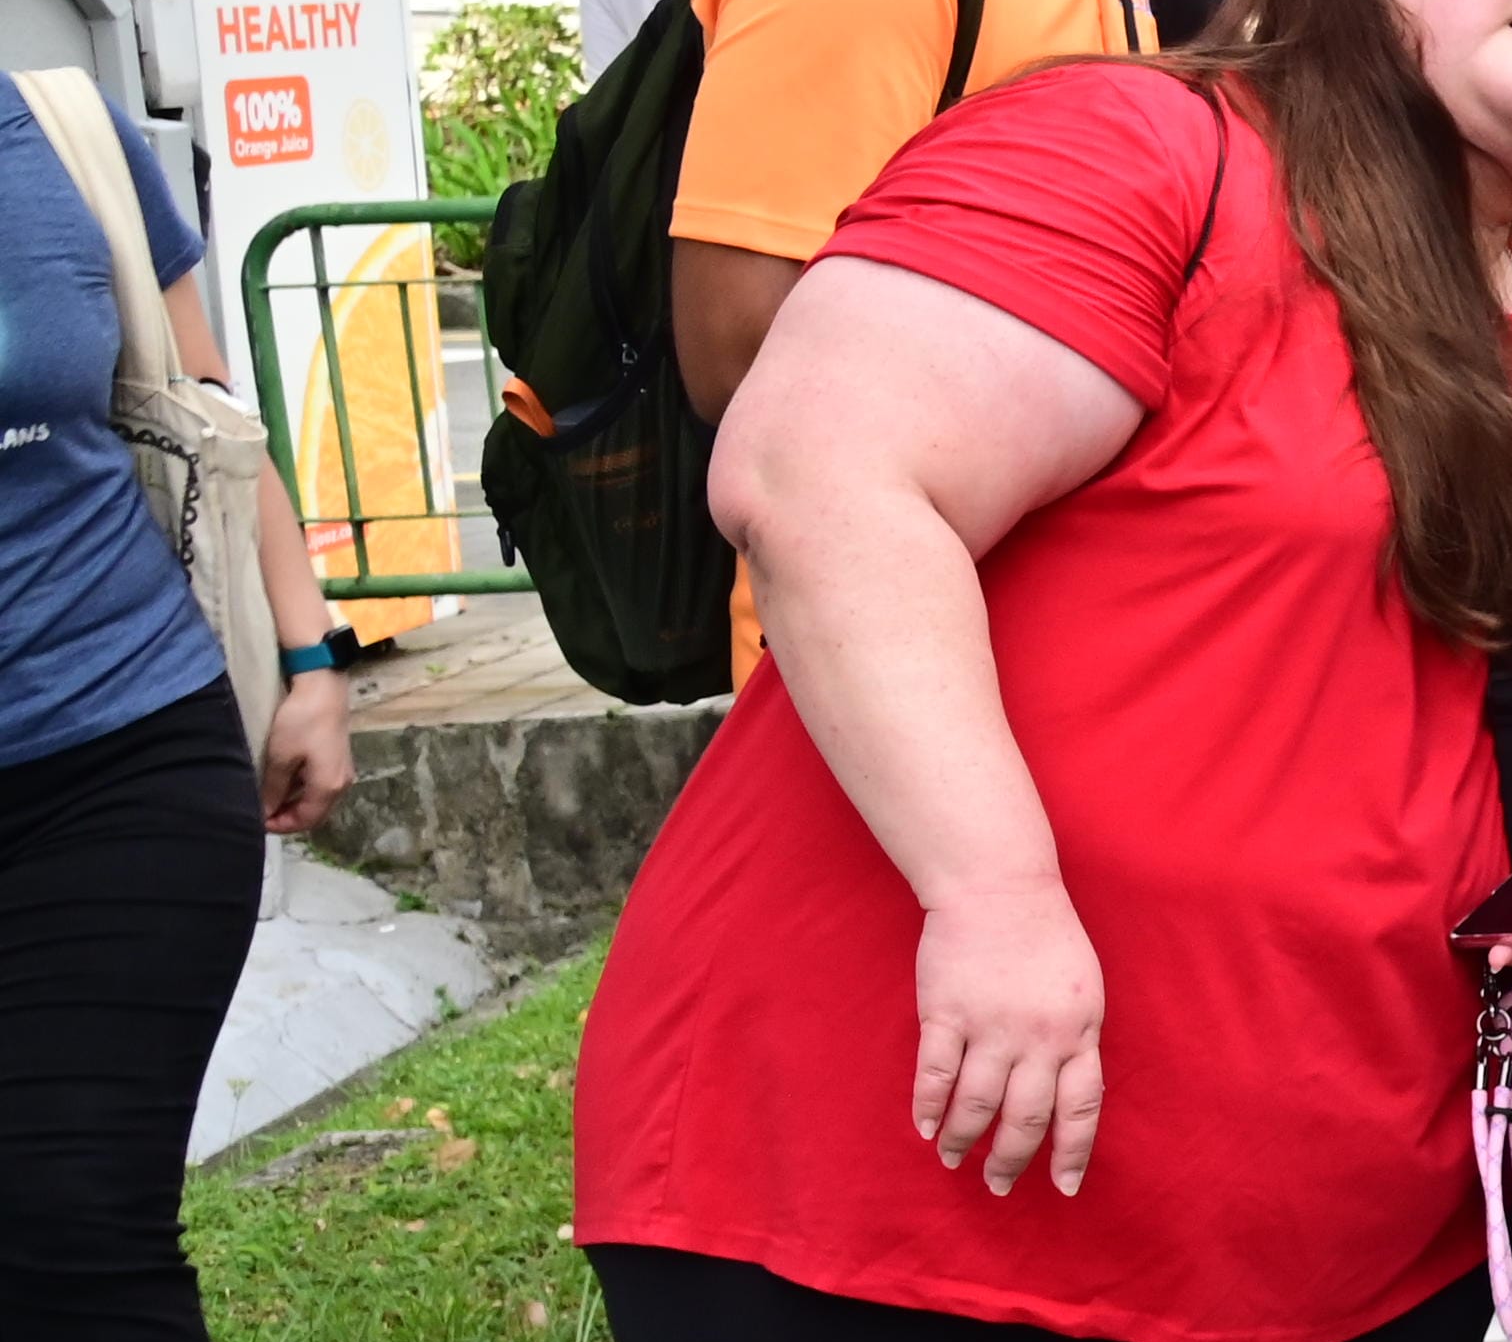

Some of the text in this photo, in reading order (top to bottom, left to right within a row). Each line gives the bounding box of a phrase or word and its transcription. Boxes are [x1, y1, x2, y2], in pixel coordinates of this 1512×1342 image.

[217, 2, 361, 54] HEALTHY
[234, 89, 302, 133] 100%
[235, 134, 309, 159] Orange Juice
